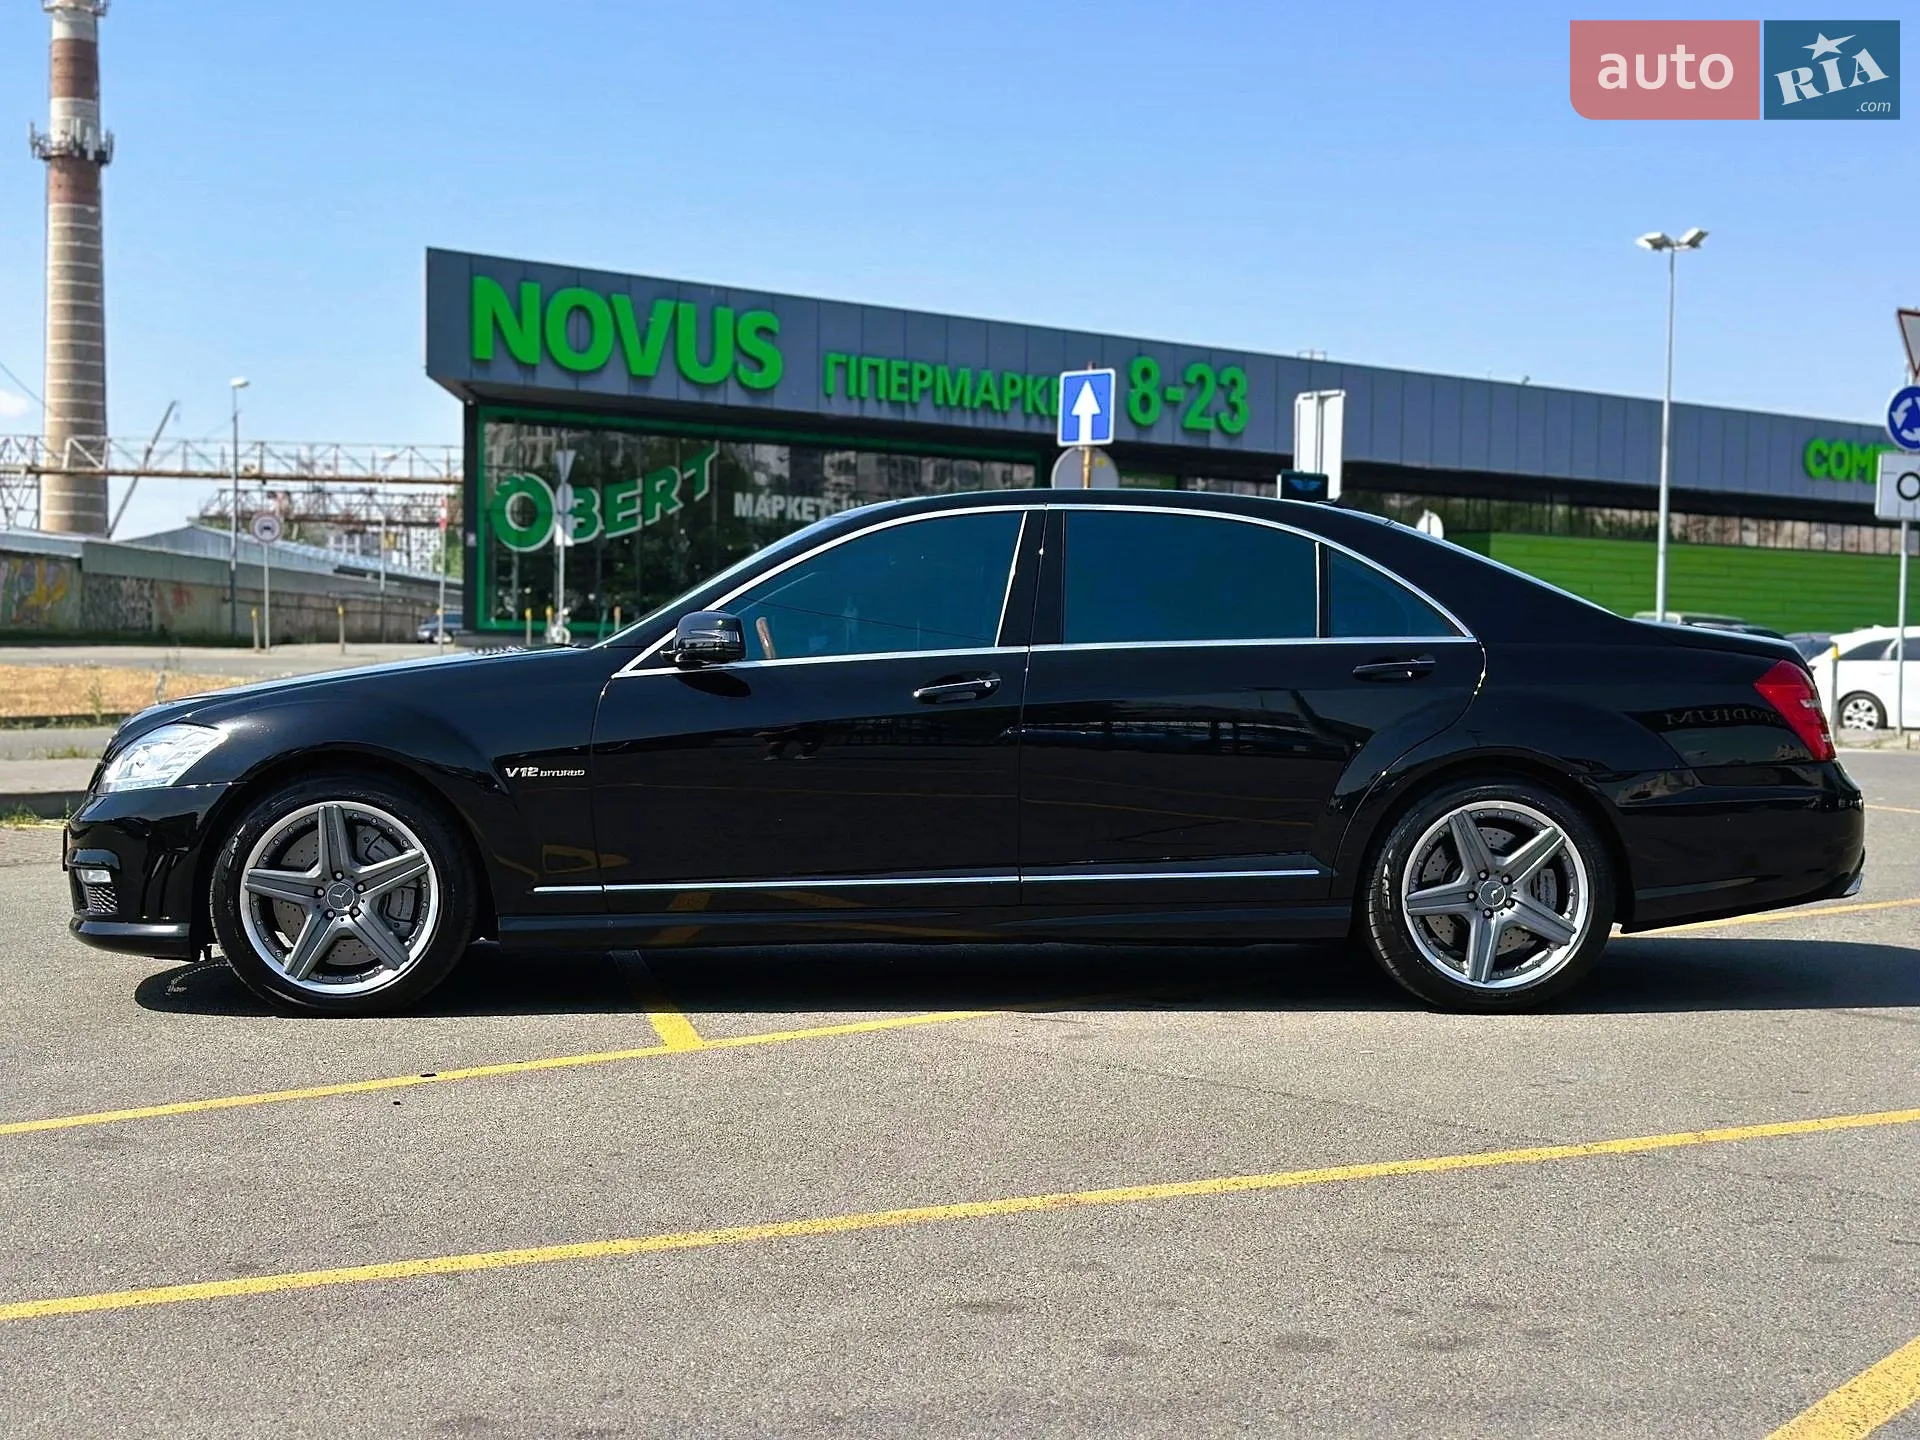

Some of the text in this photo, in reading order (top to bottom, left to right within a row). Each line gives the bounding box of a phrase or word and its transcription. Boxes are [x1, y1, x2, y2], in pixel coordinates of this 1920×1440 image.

[471, 275, 784, 390] NOVUS
[1129, 356, 1249, 435] 8-23
[1804, 437, 1896, 483] COM
[505, 766, 539, 778] V12
